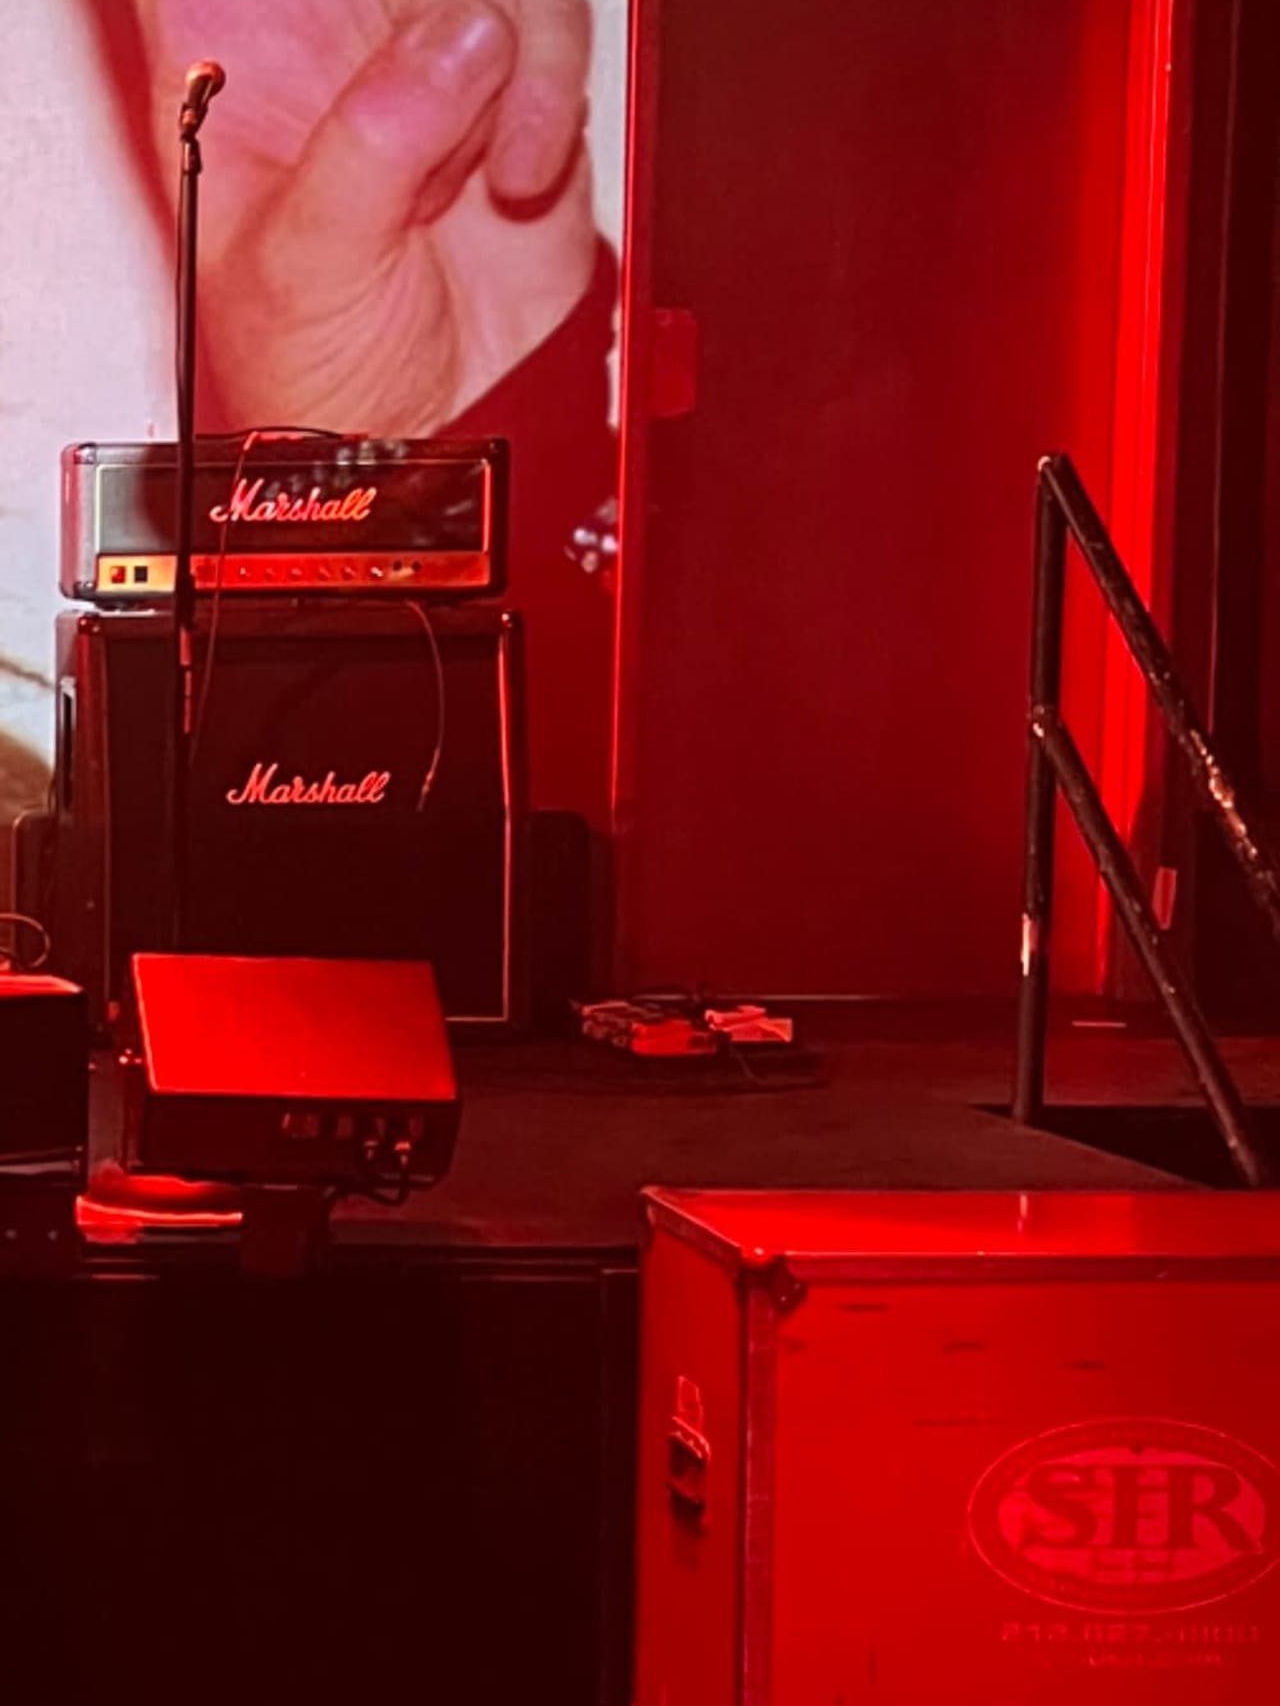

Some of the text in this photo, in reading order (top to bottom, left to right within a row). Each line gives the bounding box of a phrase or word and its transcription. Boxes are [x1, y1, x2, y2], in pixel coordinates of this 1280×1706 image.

[209, 478, 378, 523] Marshall
[225, 762, 391, 805] Marshall
[1022, 1461, 1261, 1552] SIR
